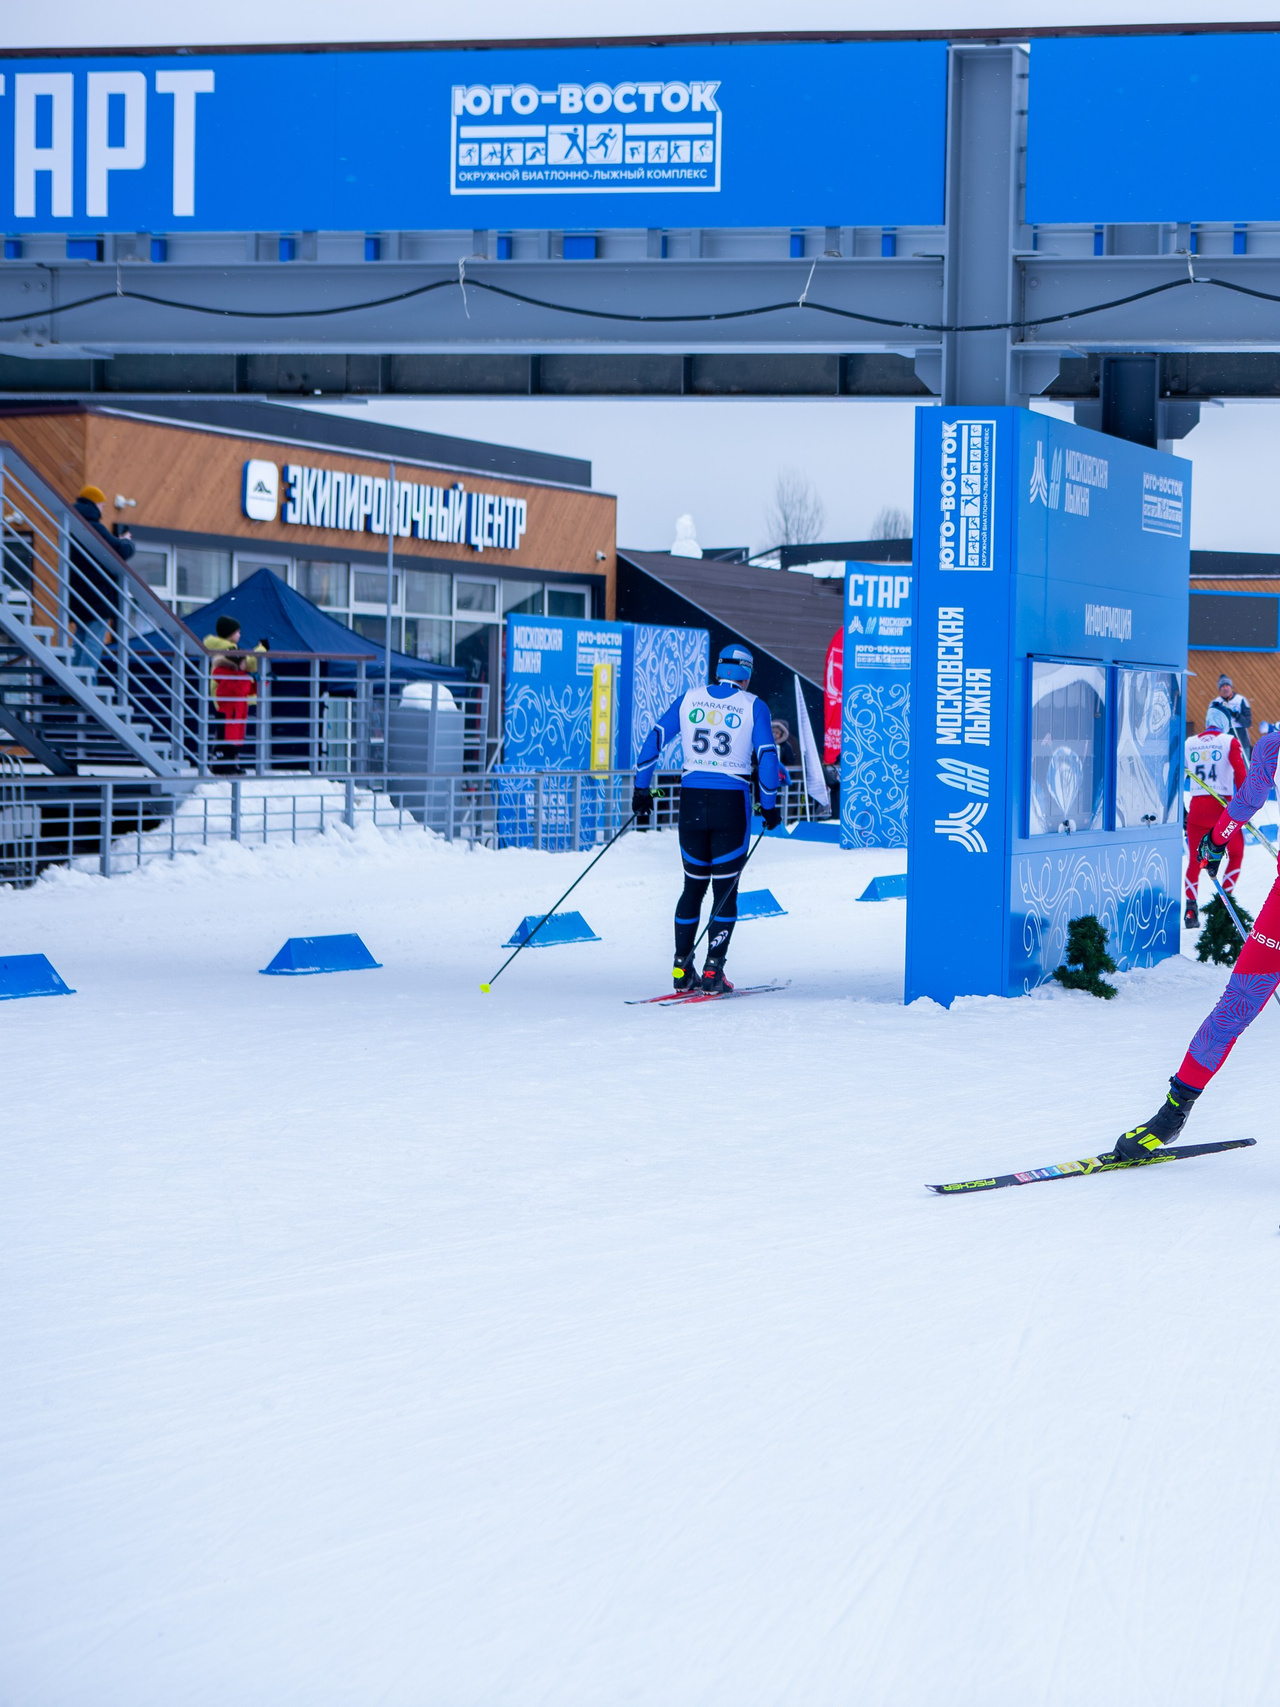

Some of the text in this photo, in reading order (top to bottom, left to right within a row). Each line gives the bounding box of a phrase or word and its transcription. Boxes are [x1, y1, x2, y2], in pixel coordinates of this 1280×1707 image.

[452, 81, 721, 116] ЮГО-ВОСТОК
[0, 69, 215, 218] АРТ
[458, 167, 708, 182] ОКРУЖНОЙ БИАТЛОННО-ЛЫЖНЫЙ КОМПЛЕКС
[1065, 448, 1109, 490] МОСКОВСКАЯ
[1143, 472, 1184, 497] ЮГО-ВОСТОК
[284, 464, 528, 552] ЭКИПИРОВОЧНЫЙ ЦЕНТР
[939, 421, 958, 570] ЮГО-ВОСТОК
[981, 461, 990, 532] БИАТЛОННО-ЛЫЖНЫЙ
[1064, 482, 1090, 517] ЛЫЖНЯ
[848, 574, 913, 609] СТАР
[513, 625, 563, 652] МОСКОВСКАЯ
[1085, 603, 1132, 643] ИНФОРМАЦИЯ
[513, 649, 542, 674] ЛЫЖНЯ
[936, 607, 964, 745] МОСКОВСКАЯ
[691, 701, 745, 715] VMARAFONE
[964, 668, 991, 747] ЛЫЖНЯ
[692, 727, 733, 758] 53
[1195, 763, 1218, 783] 54
[1100, 1155, 1177, 1173] FISCHER
[942, 1178, 996, 1191] FISCHER
